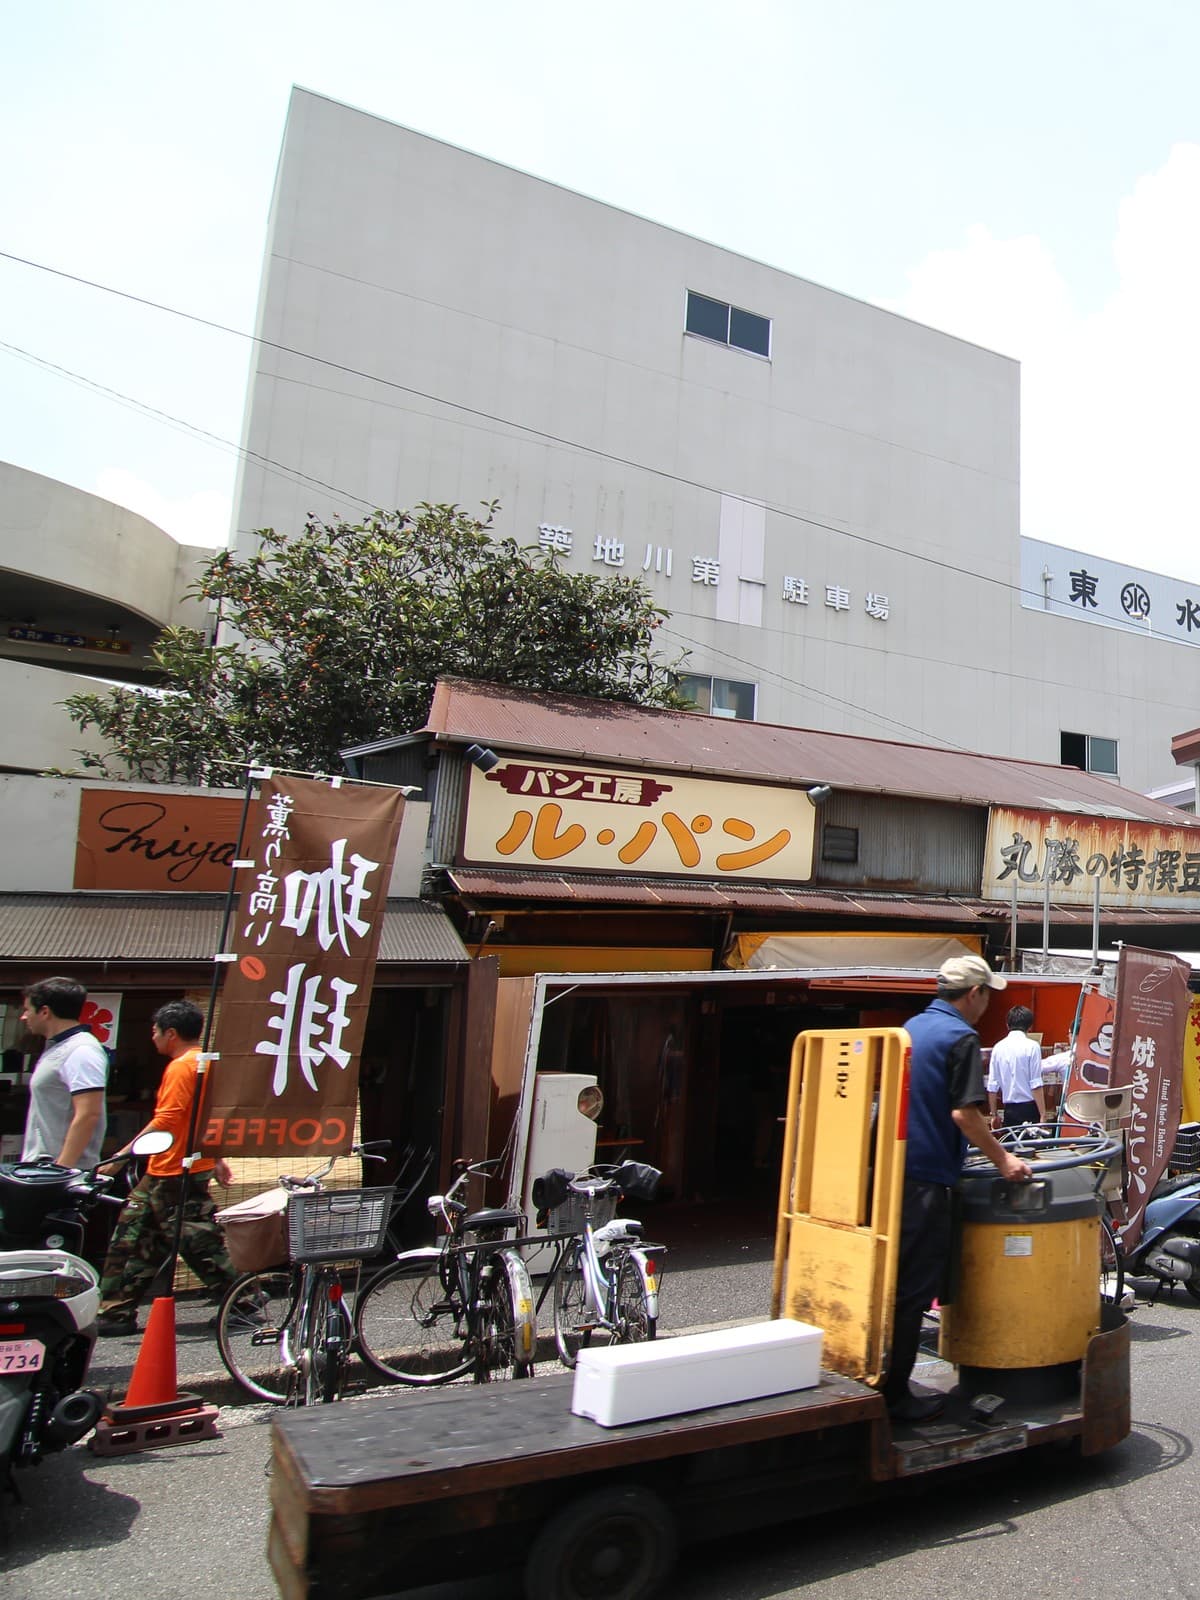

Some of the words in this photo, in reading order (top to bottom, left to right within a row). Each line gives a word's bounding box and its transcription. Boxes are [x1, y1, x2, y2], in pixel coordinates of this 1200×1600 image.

[519, 768, 643, 805] パン工房
[496, 803, 791, 871] ル・パン
[1160, 1078, 1172, 1105] Hand
[1158, 1106, 1169, 1131] Made
[1155, 1132, 1168, 1159] Bakery
